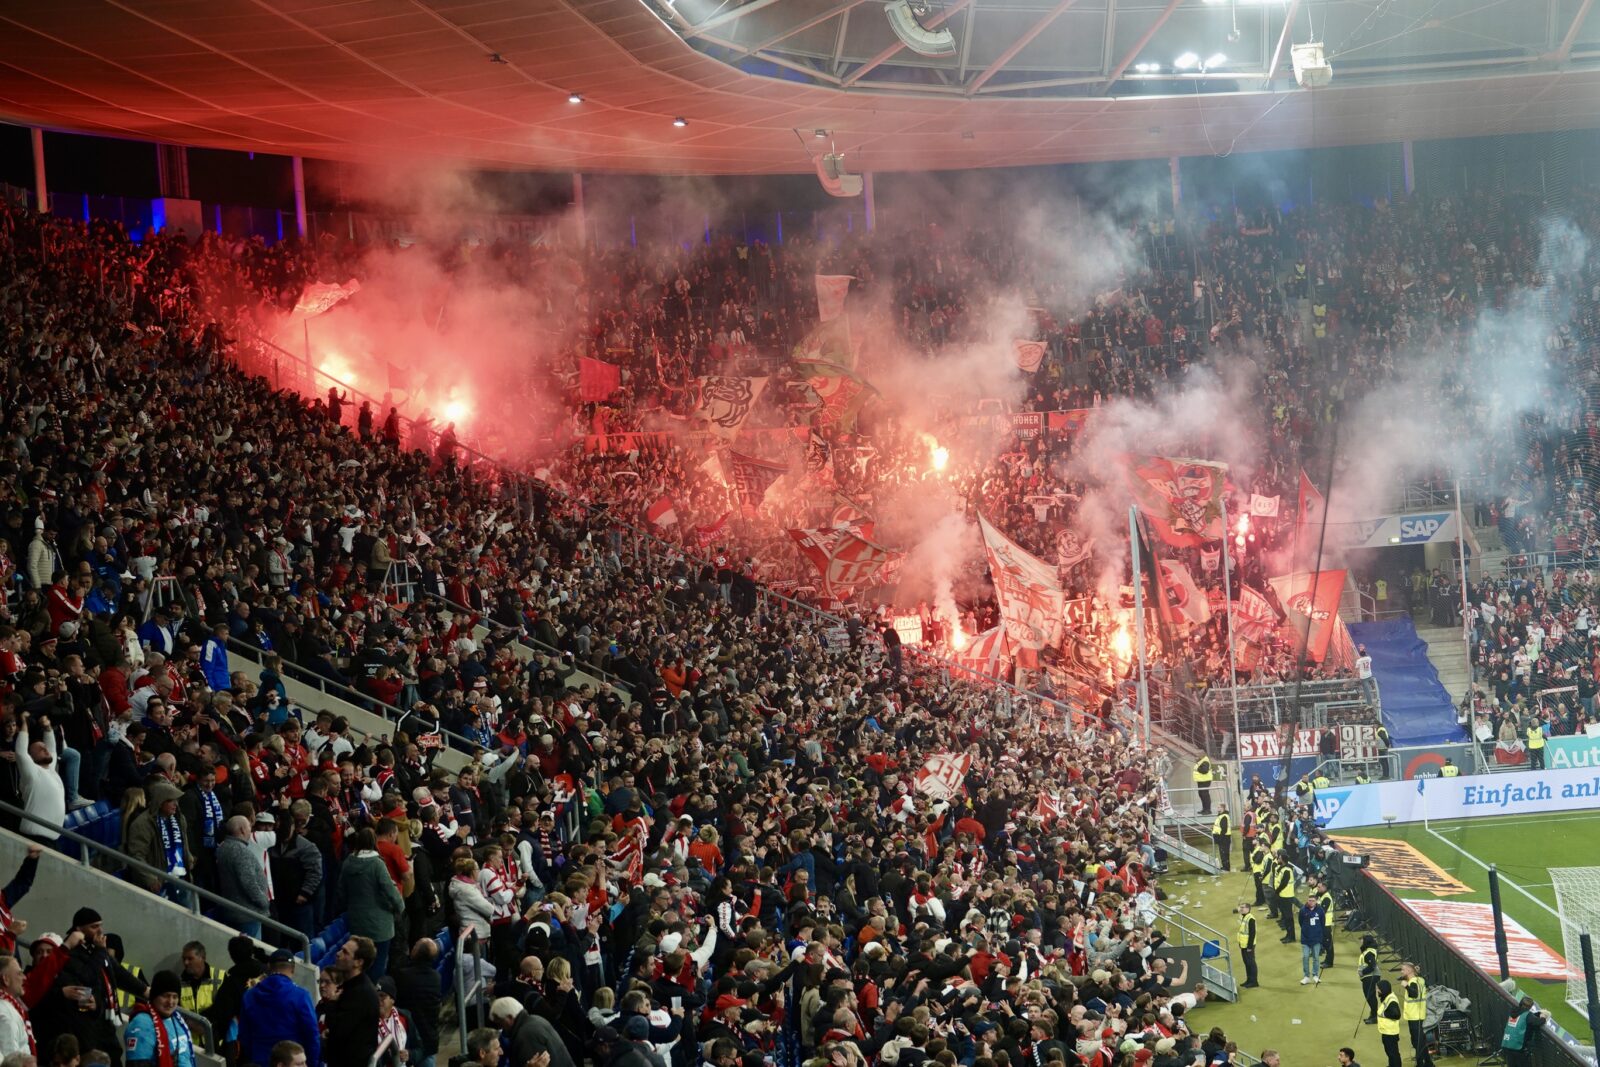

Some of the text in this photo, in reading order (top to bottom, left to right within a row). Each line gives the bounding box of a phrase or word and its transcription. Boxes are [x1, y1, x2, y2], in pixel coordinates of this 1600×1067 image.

[1401, 519, 1439, 538] SAP
[1462, 781, 1552, 807] Einfach
[1313, 797, 1341, 819] AP
